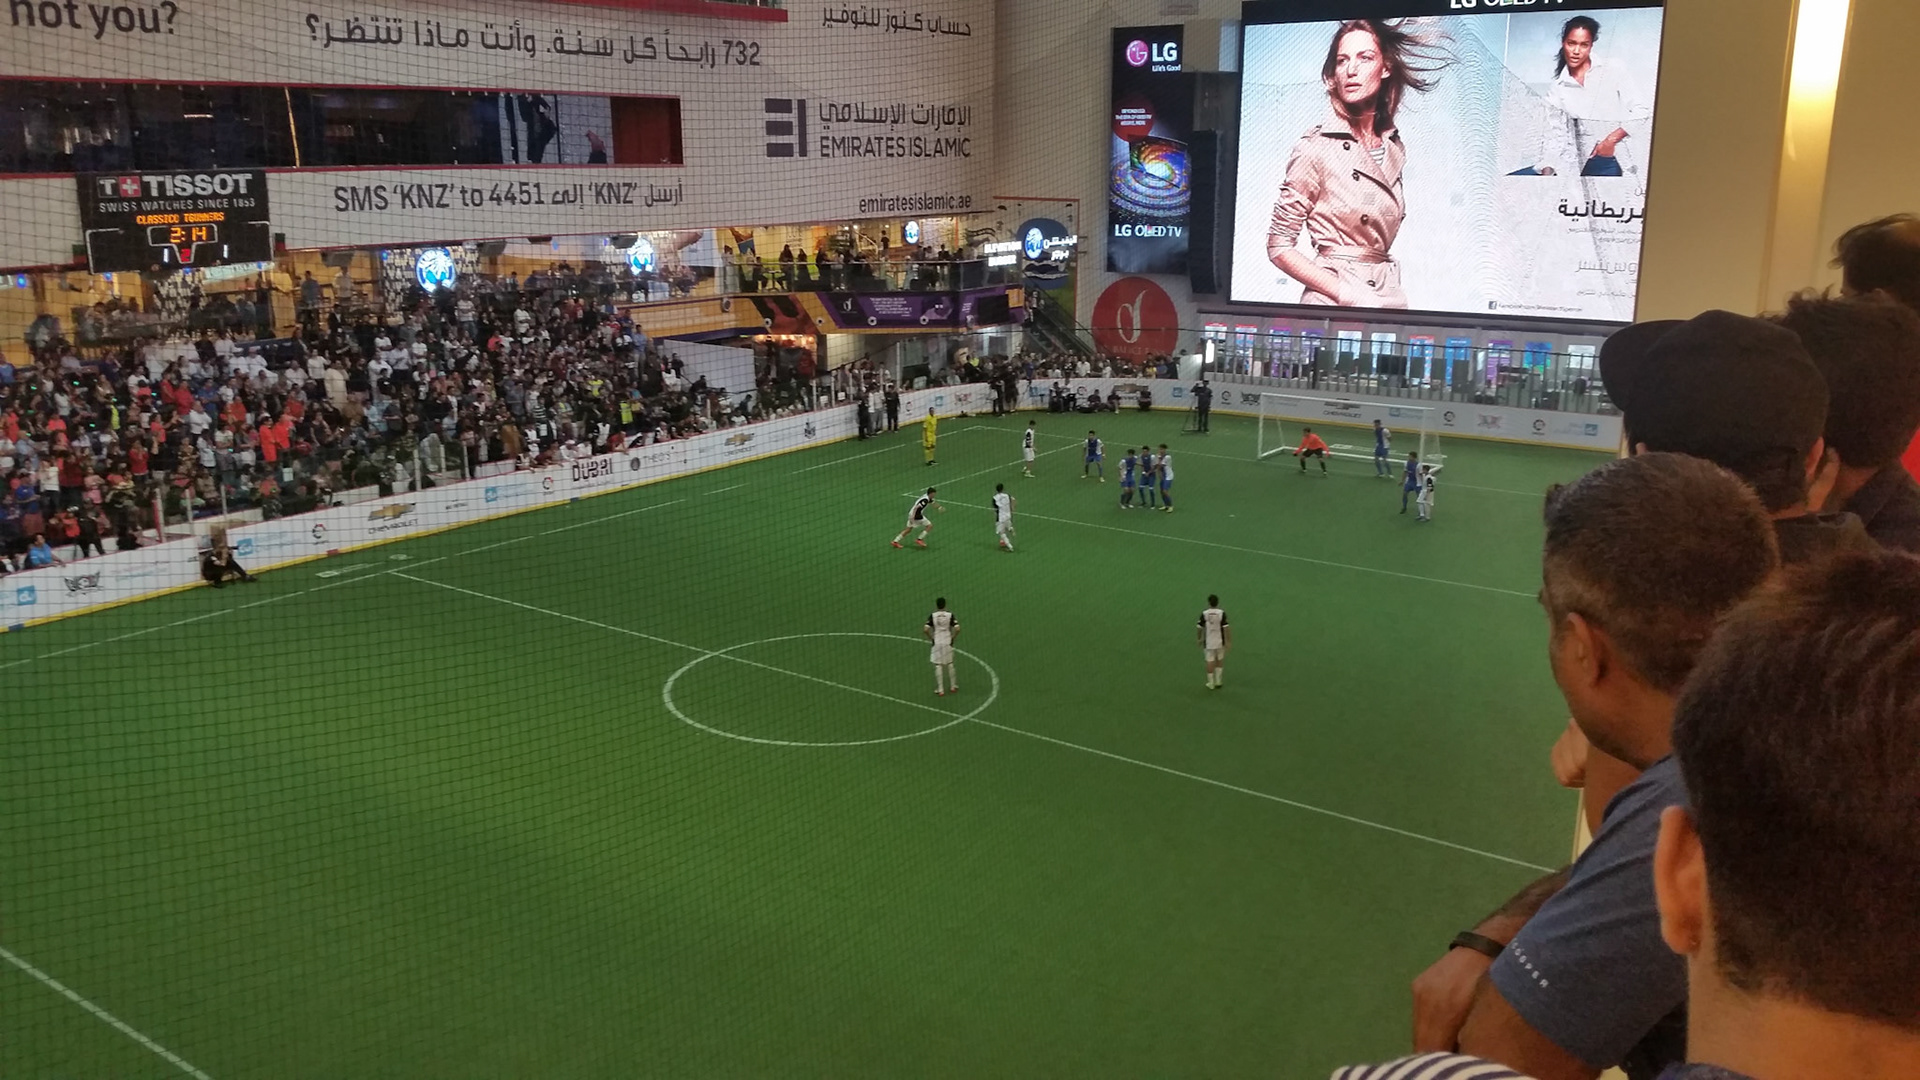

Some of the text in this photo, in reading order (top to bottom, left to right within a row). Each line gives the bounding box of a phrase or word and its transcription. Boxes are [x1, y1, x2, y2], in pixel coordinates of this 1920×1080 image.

[10, 0, 178, 40] not you?
[306, 13, 403, 48] تنتظر؟
[414, 19, 469, 48] ماذا
[822, 4, 971, 38] حساب كنوز للتوفير
[480, 19, 536, 58] وأنت
[624, 35, 657, 64] كل
[722, 39, 761, 66] 732
[1152, 42, 1177, 61] LG
[819, 102, 972, 132] الإمارات الإسلامي
[820, 136, 971, 158] EMIRATES ISLAMIC
[142, 173, 253, 197] TISSOT
[334, 185, 389, 212] SMS
[459, 185, 483, 207] to
[489, 181, 545, 206] 4451
[551, 183, 583, 209] إلى
[644, 177, 683, 208] أرسل
[99, 197, 256, 213] SWISS WATCHES SINCE 1853
[859, 192, 972, 214] emiratesislamic.ae
[1114, 224, 1182, 237] LG OLED TV
